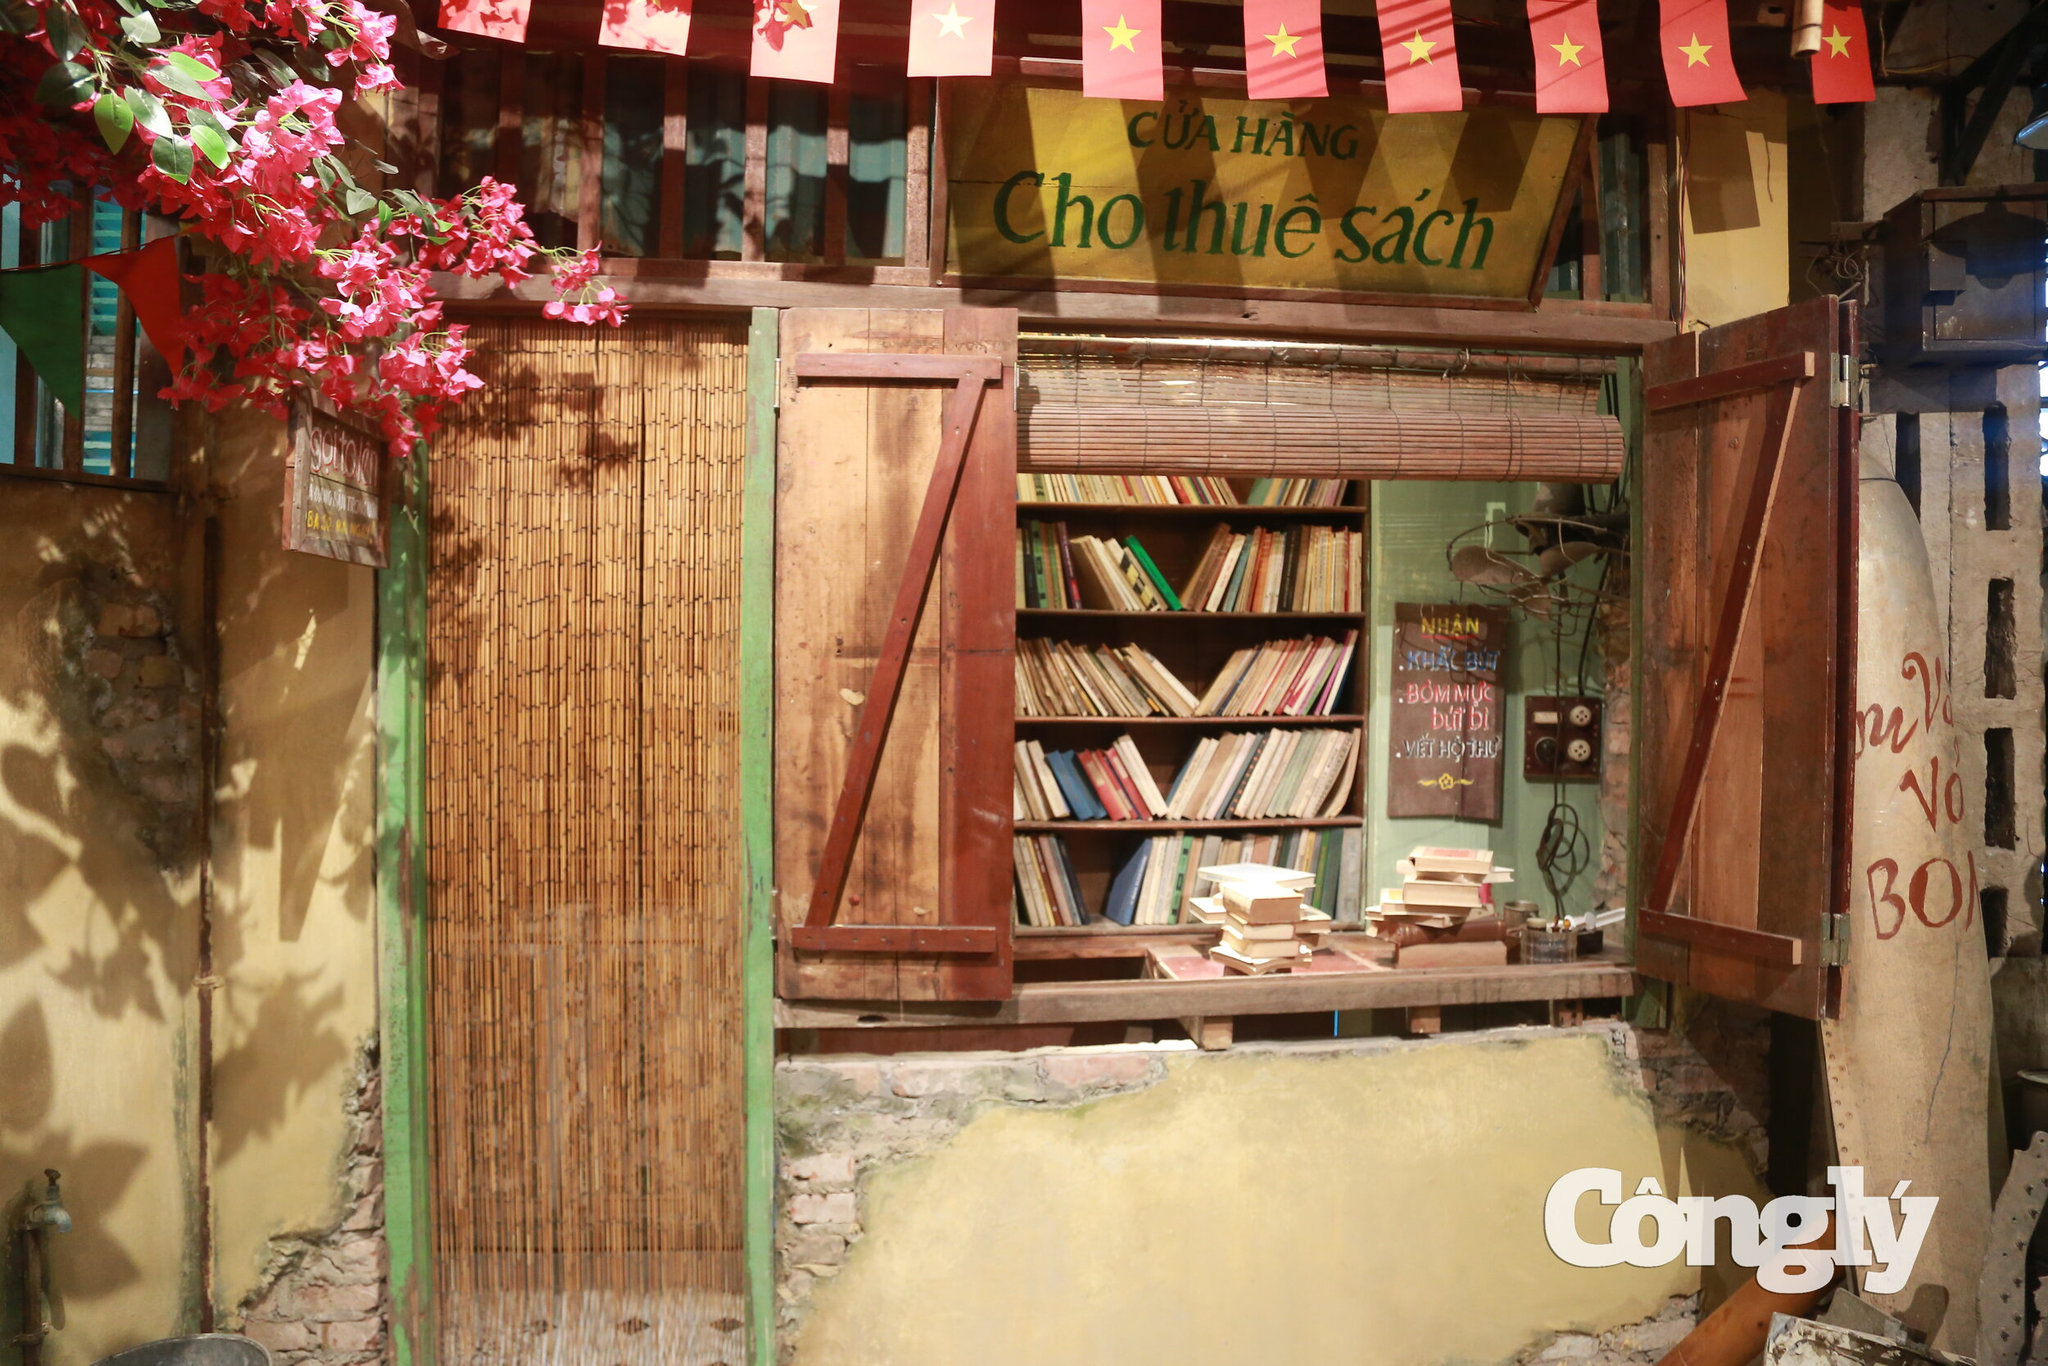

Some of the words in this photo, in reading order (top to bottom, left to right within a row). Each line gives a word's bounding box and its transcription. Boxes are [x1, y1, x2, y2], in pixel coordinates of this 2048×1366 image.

[1127, 100, 1220, 153] CỬA
[1231, 108, 1359, 161] HÀNG
[993, 170, 1145, 249] Cho
[1162, 178, 1323, 258] thuê
[1335, 188, 1495, 270] sách
[1421, 613, 1479, 637] NHẬN
[1404, 733, 1435, 759] VIẾT
[1438, 736, 1465, 763] HỘ
